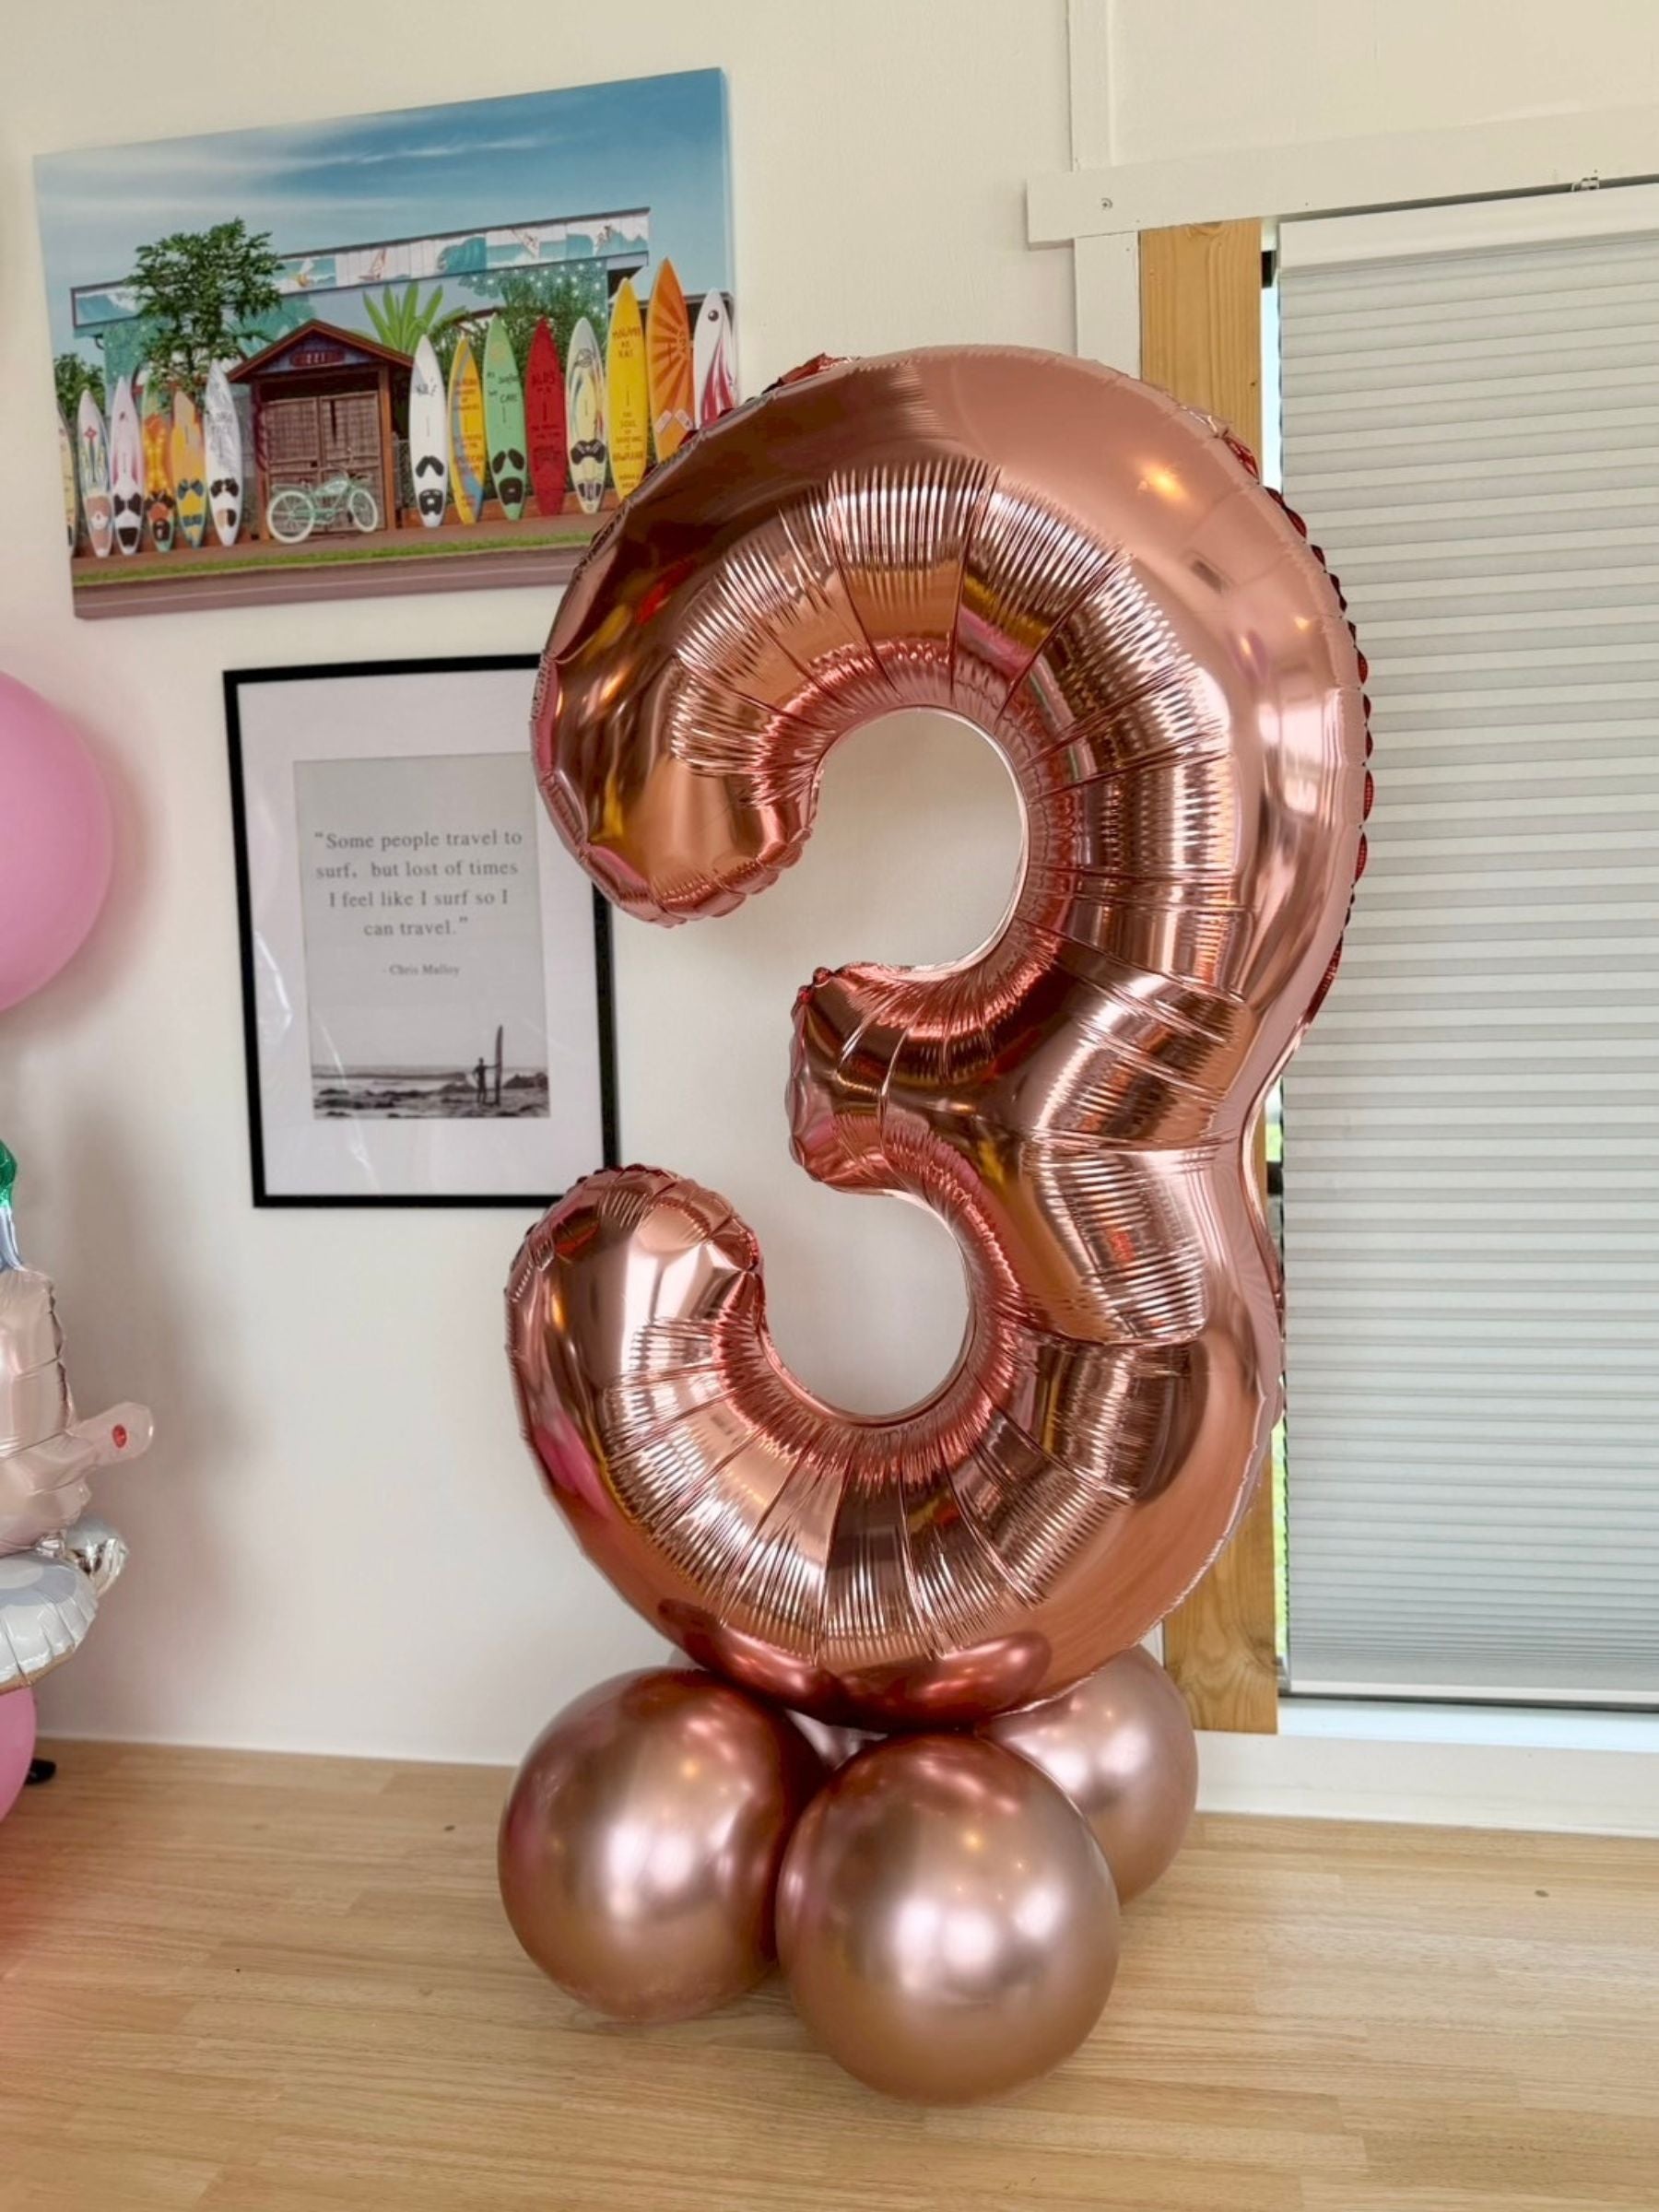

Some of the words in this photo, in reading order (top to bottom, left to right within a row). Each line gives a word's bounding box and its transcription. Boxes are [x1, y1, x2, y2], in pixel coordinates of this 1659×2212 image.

[382, 831, 439, 851] people
[446, 830, 498, 845] travel
[504, 830, 523, 845] to
[371, 861, 399, 877] but
[406, 861, 438, 877] lost
[444, 860, 463, 876] of
[469, 860, 518, 876] times
[329, 892, 335, 908] I
[342, 891, 373, 907] feel
[381, 890, 413, 906] like
[420, 890, 427, 905] I
[434, 889, 469, 905] surf
[476, 893, 495, 905] so
[501, 888, 508, 904] I
[363, 922, 394, 935] can
